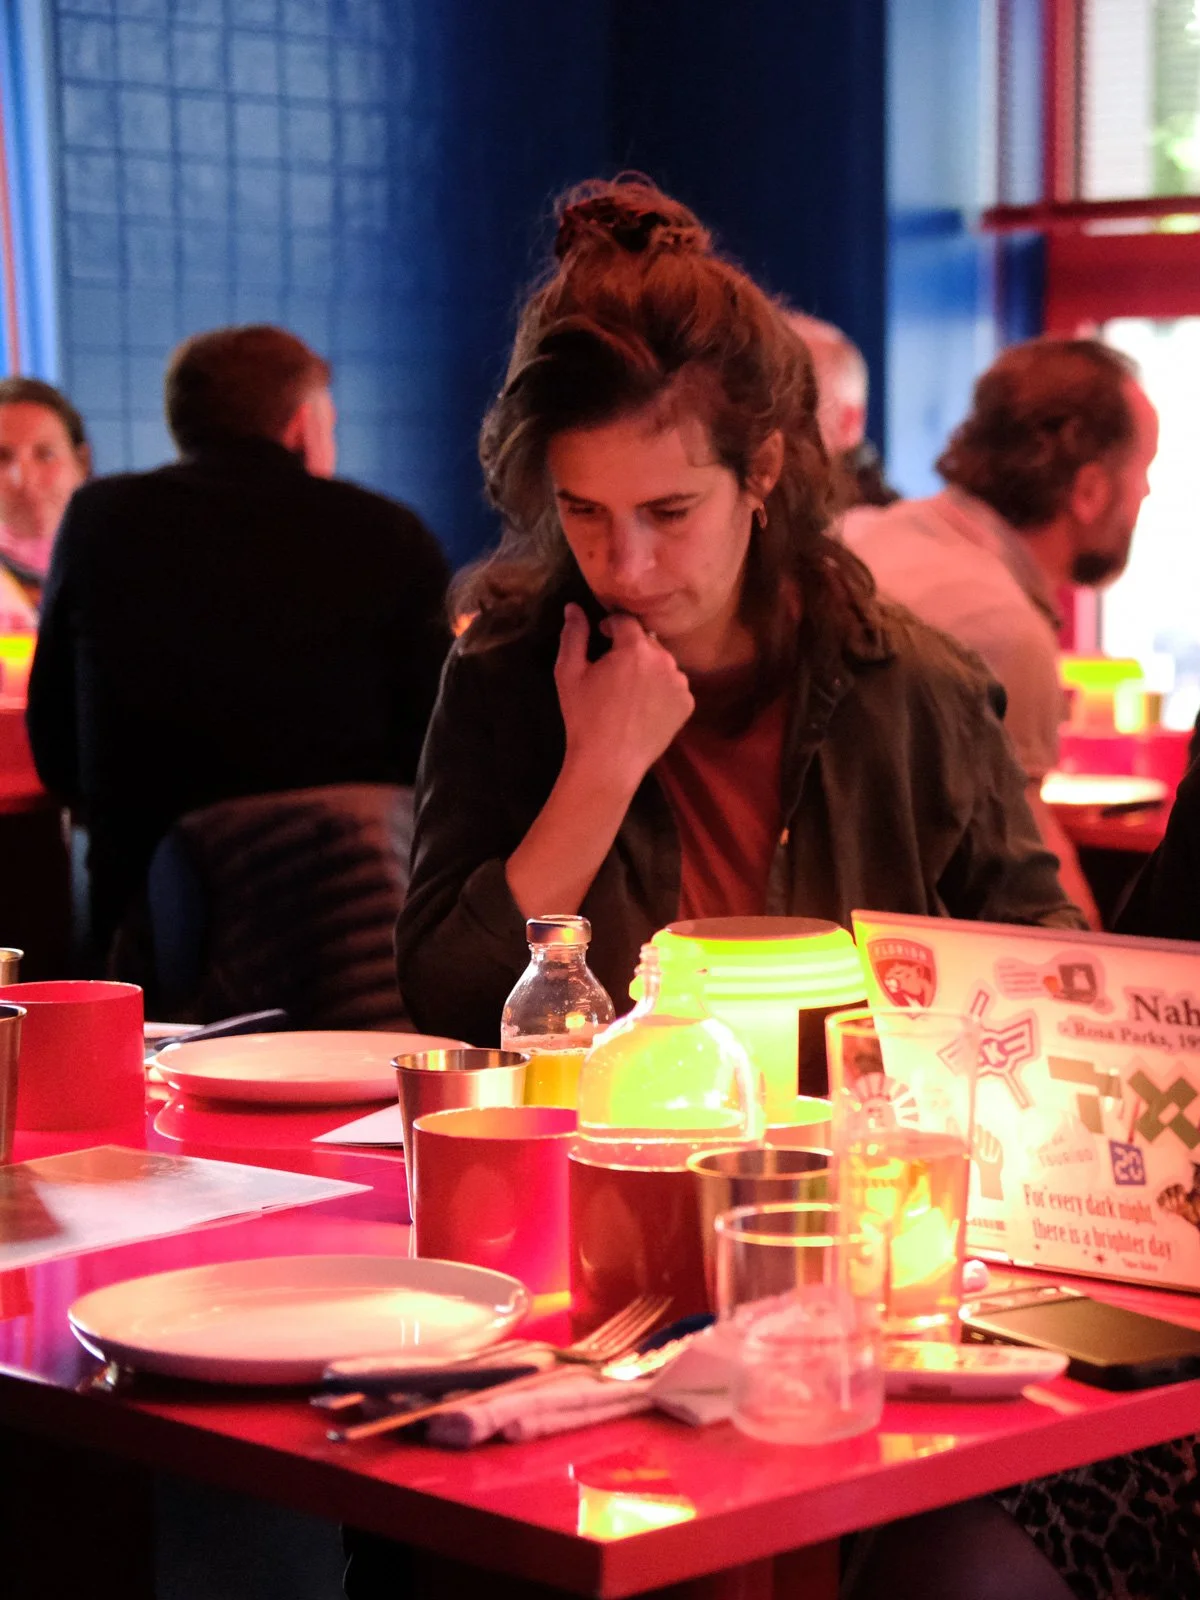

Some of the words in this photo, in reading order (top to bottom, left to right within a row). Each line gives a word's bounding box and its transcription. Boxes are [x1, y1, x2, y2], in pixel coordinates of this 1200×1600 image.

[1073, 1021, 1115, 1040] Rosa
[1120, 1027, 1174, 1049] Parks,
[1114, 1145, 1144, 1181] 20
[1049, 1192, 1083, 1217] every
[1086, 1193, 1117, 1219] dark
[1033, 1217, 1067, 1243] there
[1069, 1226, 1081, 1245] is
[1083, 1230, 1092, 1247] a
[1092, 1226, 1146, 1255] brighter
[1149, 1234, 1172, 1260] day
